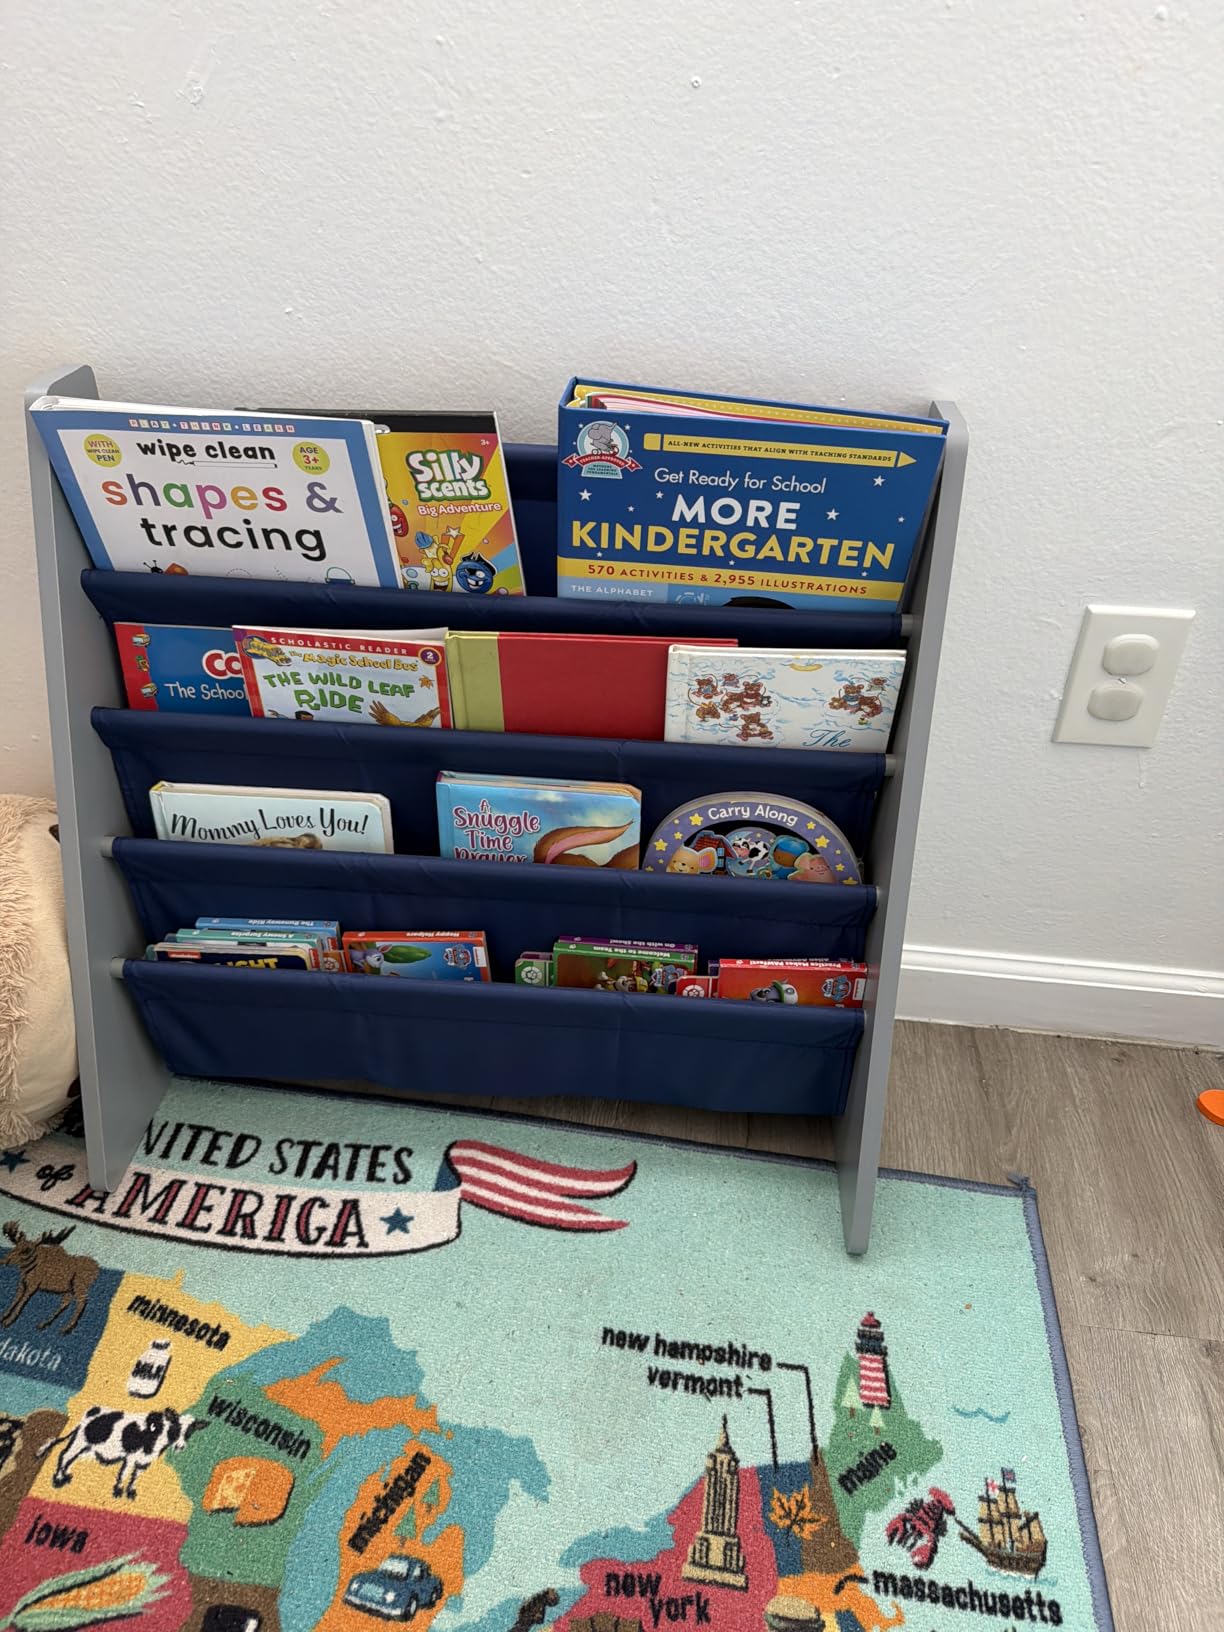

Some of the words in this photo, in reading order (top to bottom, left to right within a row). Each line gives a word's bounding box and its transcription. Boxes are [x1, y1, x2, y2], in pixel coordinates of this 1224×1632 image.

[88, 440, 114, 448] WITH
[136, 439, 197, 462] wipe
[205, 441, 276, 460] clean
[300, 446, 318, 454] AGE
[743, 445, 763, 453] THAT
[788, 448, 809, 456] WITH
[810, 450, 847, 459] TEACHING
[849, 453, 892, 462] STANDARDS
[96, 454, 115, 462] PEN
[303, 455, 319, 465] 3+
[408, 452, 481, 482] Silly
[418, 479, 489, 497] scents
[654, 467, 684, 483] Get
[689, 469, 739, 491] Ready
[744, 472, 767, 489] for
[771, 475, 827, 494] School
[102, 473, 288, 519] shapes
[306, 482, 344, 513] &
[418, 505, 439, 517] Big
[440, 503, 502, 514] Adventure
[671, 494, 801, 530] MORE
[140, 518, 327, 562] tracing
[571, 520, 895, 570] KINDERGARTEN
[571, 584, 593, 593] THE
[596, 586, 654, 597] ALPHABET
[588, 564, 615, 575] 570
[620, 568, 694, 581] ACTIVITIES
[700, 574, 708, 582] &
[714, 573, 755, 586] 2,955
[760, 579, 868, 595] ILLUSTRATIONS
[271, 637, 351, 650] SCHOLASTIC
[360, 645, 408, 655] READER
[426, 651, 434, 660] 2
[303, 653, 347, 667] Magic
[349, 655, 391, 669] School
[393, 659, 418, 672] Bus
[164, 681, 196, 698] The
[201, 682, 249, 700] School
[263, 671, 303, 688] THE
[308, 671, 362, 690] WILD
[368, 680, 415, 698] LEAF
[294, 688, 364, 714] RIDE
[802, 729, 852, 748] The
[171, 812, 260, 841] Mommy
[258, 808, 316, 830] Loves
[319, 807, 369, 837] You!
[453, 806, 540, 837] Snuggle
[707, 805, 750, 821] Carry
[754, 805, 799, 827] Along
[464, 829, 513, 851] Time
[144, 1118, 262, 1170] NITED
[268, 1137, 414, 1186] STATES
[36, 1164, 76, 1191] of
[127, 1294, 233, 1352] minnesota
[601, 1326, 650, 1352] new
[654, 1333, 773, 1371] hampshire
[648, 1365, 744, 1399] vermont
[207, 1391, 312, 1461] wisconsin
[25, 1514, 90, 1554] iowa
[604, 1571, 662, 1598] new
[872, 1570, 1063, 1626] massachusetts
[649, 1592, 711, 1628] york
